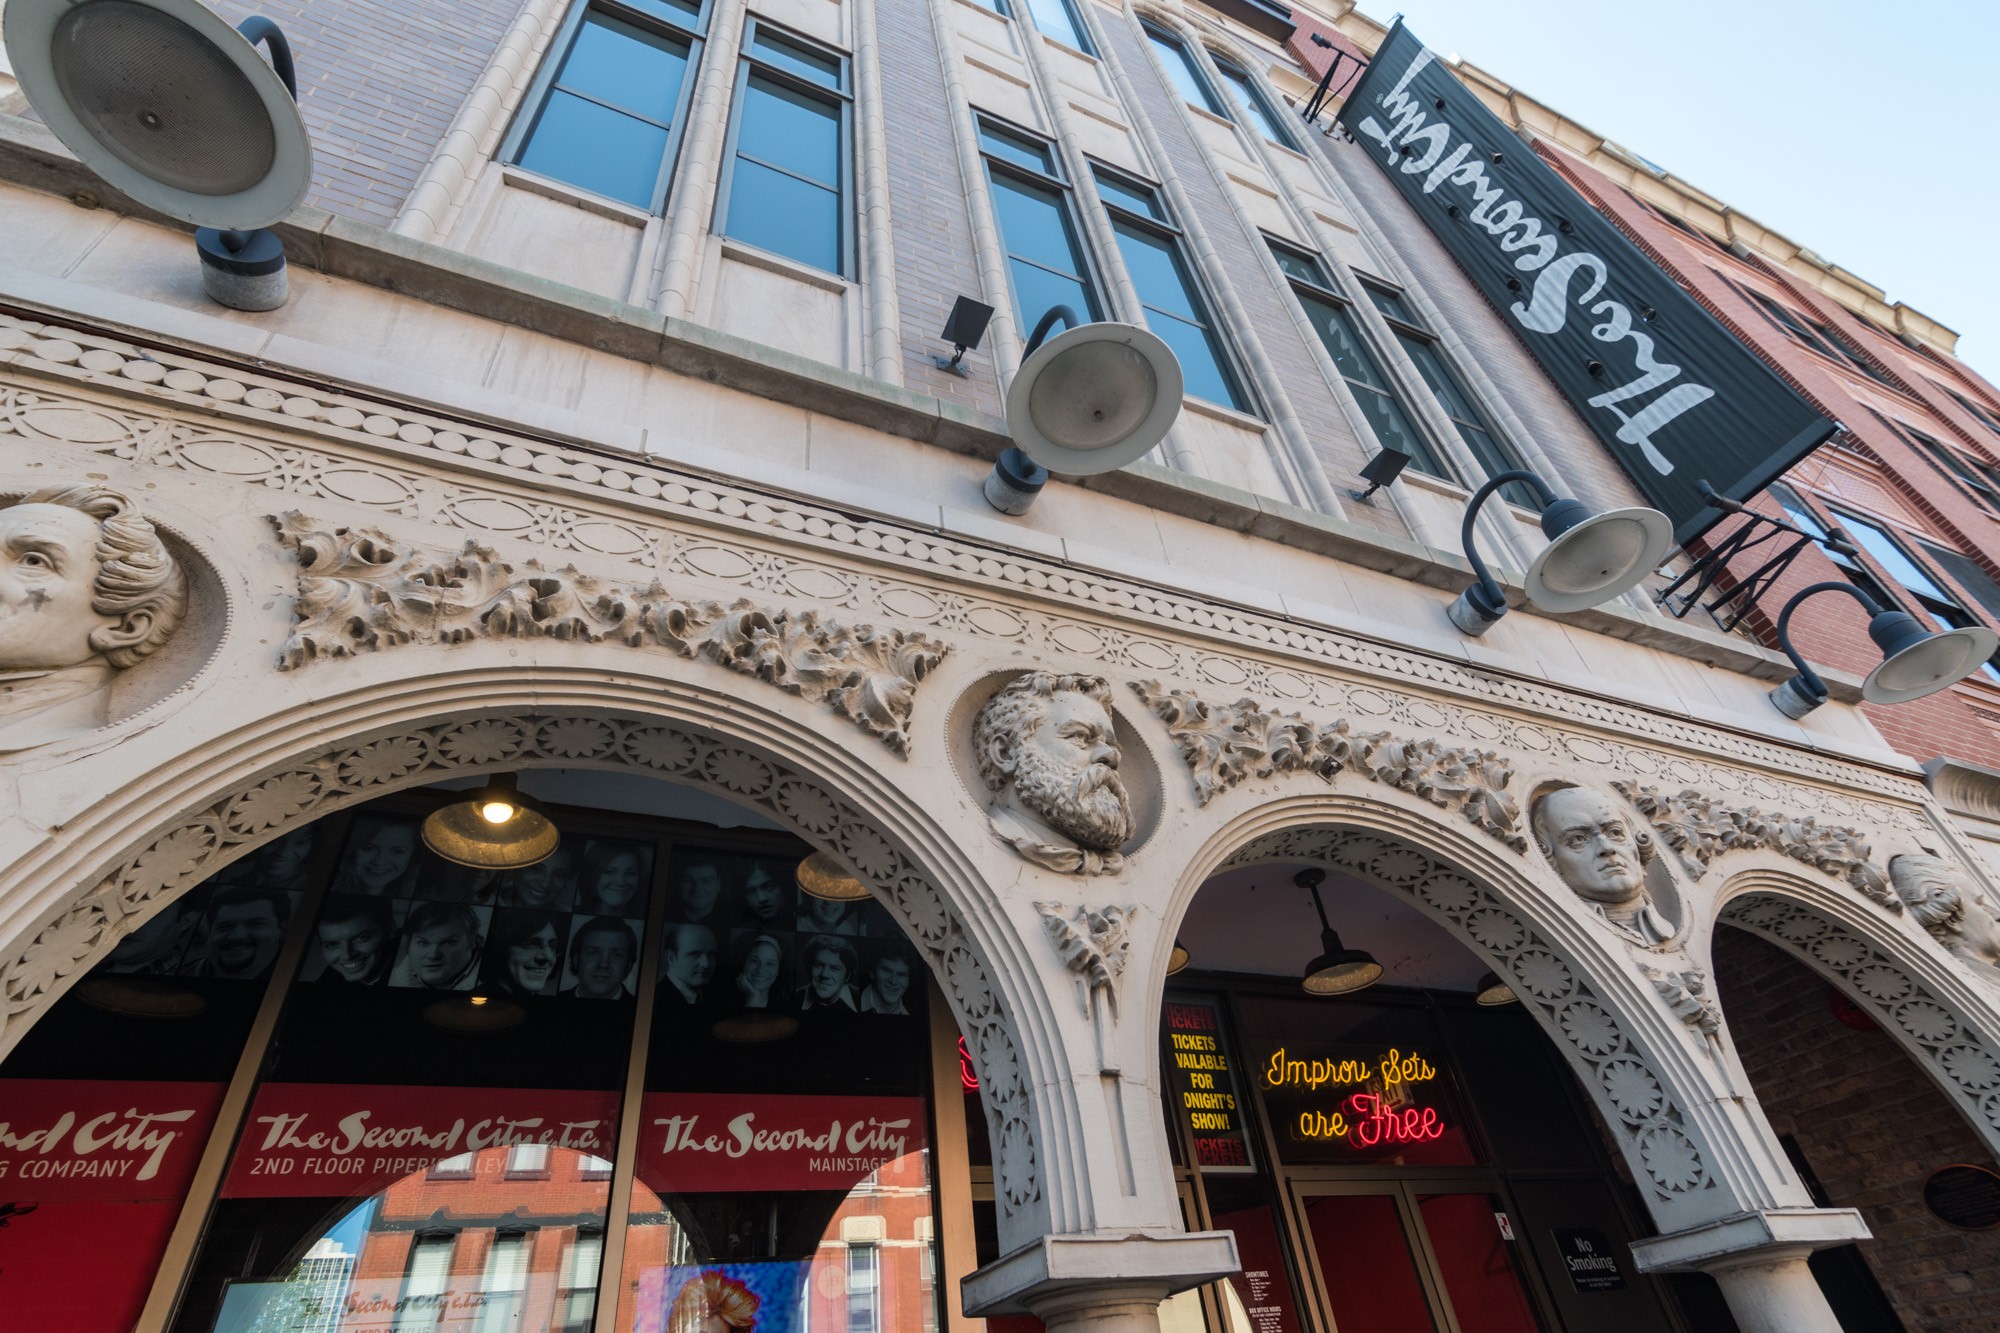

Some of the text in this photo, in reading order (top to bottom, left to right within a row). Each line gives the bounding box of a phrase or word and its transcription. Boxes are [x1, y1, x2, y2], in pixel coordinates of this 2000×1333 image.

[1358, 46, 1716, 477] The Second City
[1172, 1034, 1216, 1051] TICKETS
[1175, 1053, 1227, 1071] VAILABLE
[1267, 1048, 1371, 1090] Improv
[1381, 1048, 1436, 1090] Sets
[1190, 1073, 1215, 1089] FOR
[1184, 1093, 1235, 1110] ONIGHT'S
[1191, 1113, 1231, 1130] SHOW!
[1300, 1092, 1444, 1144] are Free
[257, 1113, 331, 1151] The
[331, 1110, 465, 1155] Second
[73, 1107, 196, 1181] City
[654, 1112, 911, 1173] The Second City
[1194, 1138, 1242, 1152] ICKETS
[19, 1159, 134, 1178] COMPANY
[250, 1158, 295, 1175] 2ND
[302, 1158, 365, 1174] FLOOR
[809, 1157, 888, 1172] MAINSTAGE
[1575, 1238, 1593, 1252] No
[1567, 1254, 1617, 1272] Smoking
[340, 1291, 411, 1319] Second
[412, 1291, 456, 1322] City
